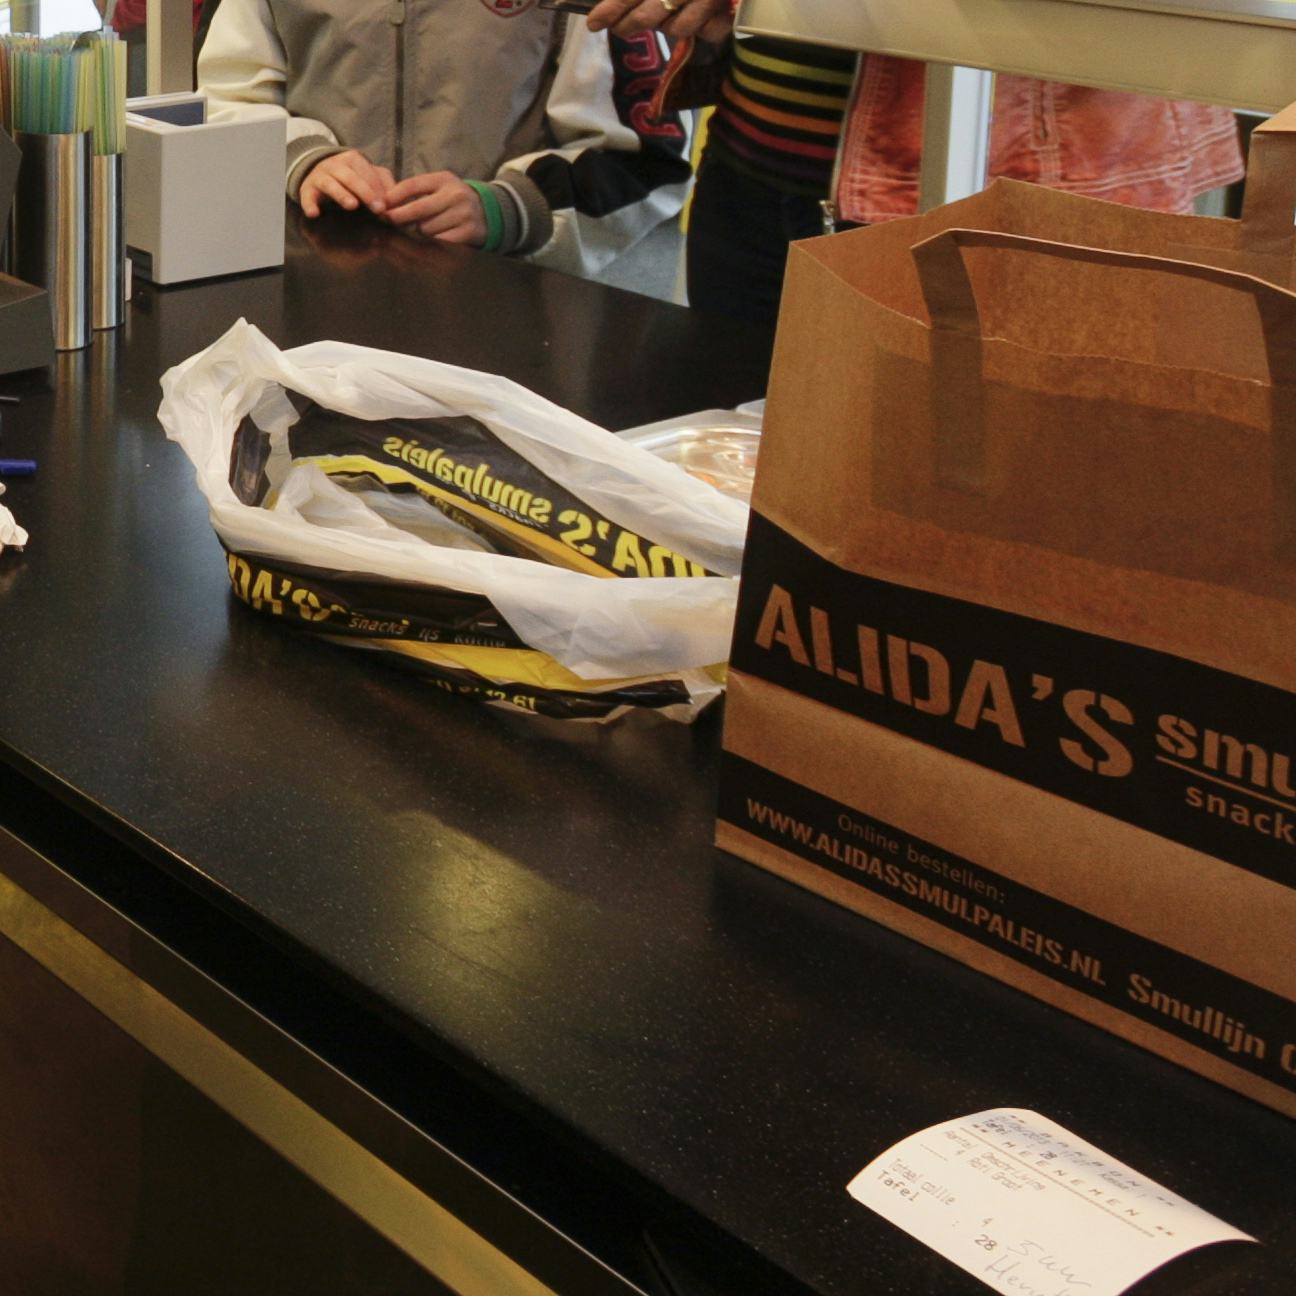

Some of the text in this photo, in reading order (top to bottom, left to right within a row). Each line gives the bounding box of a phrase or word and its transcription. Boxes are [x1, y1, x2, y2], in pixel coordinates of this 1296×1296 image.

[347, 615, 407, 635] snacks
[754, 583, 1136, 778] ALIDA'S
[837, 813, 1006, 904] Online bestellen:
[1185, 786, 1296, 846] snack
[746, 797, 1107, 986] WWW.ALIDASSMULPALEIS.NL
[1127, 971, 1266, 1060] Smullijn
[876, 1169, 998, 1252] Tafel 28
